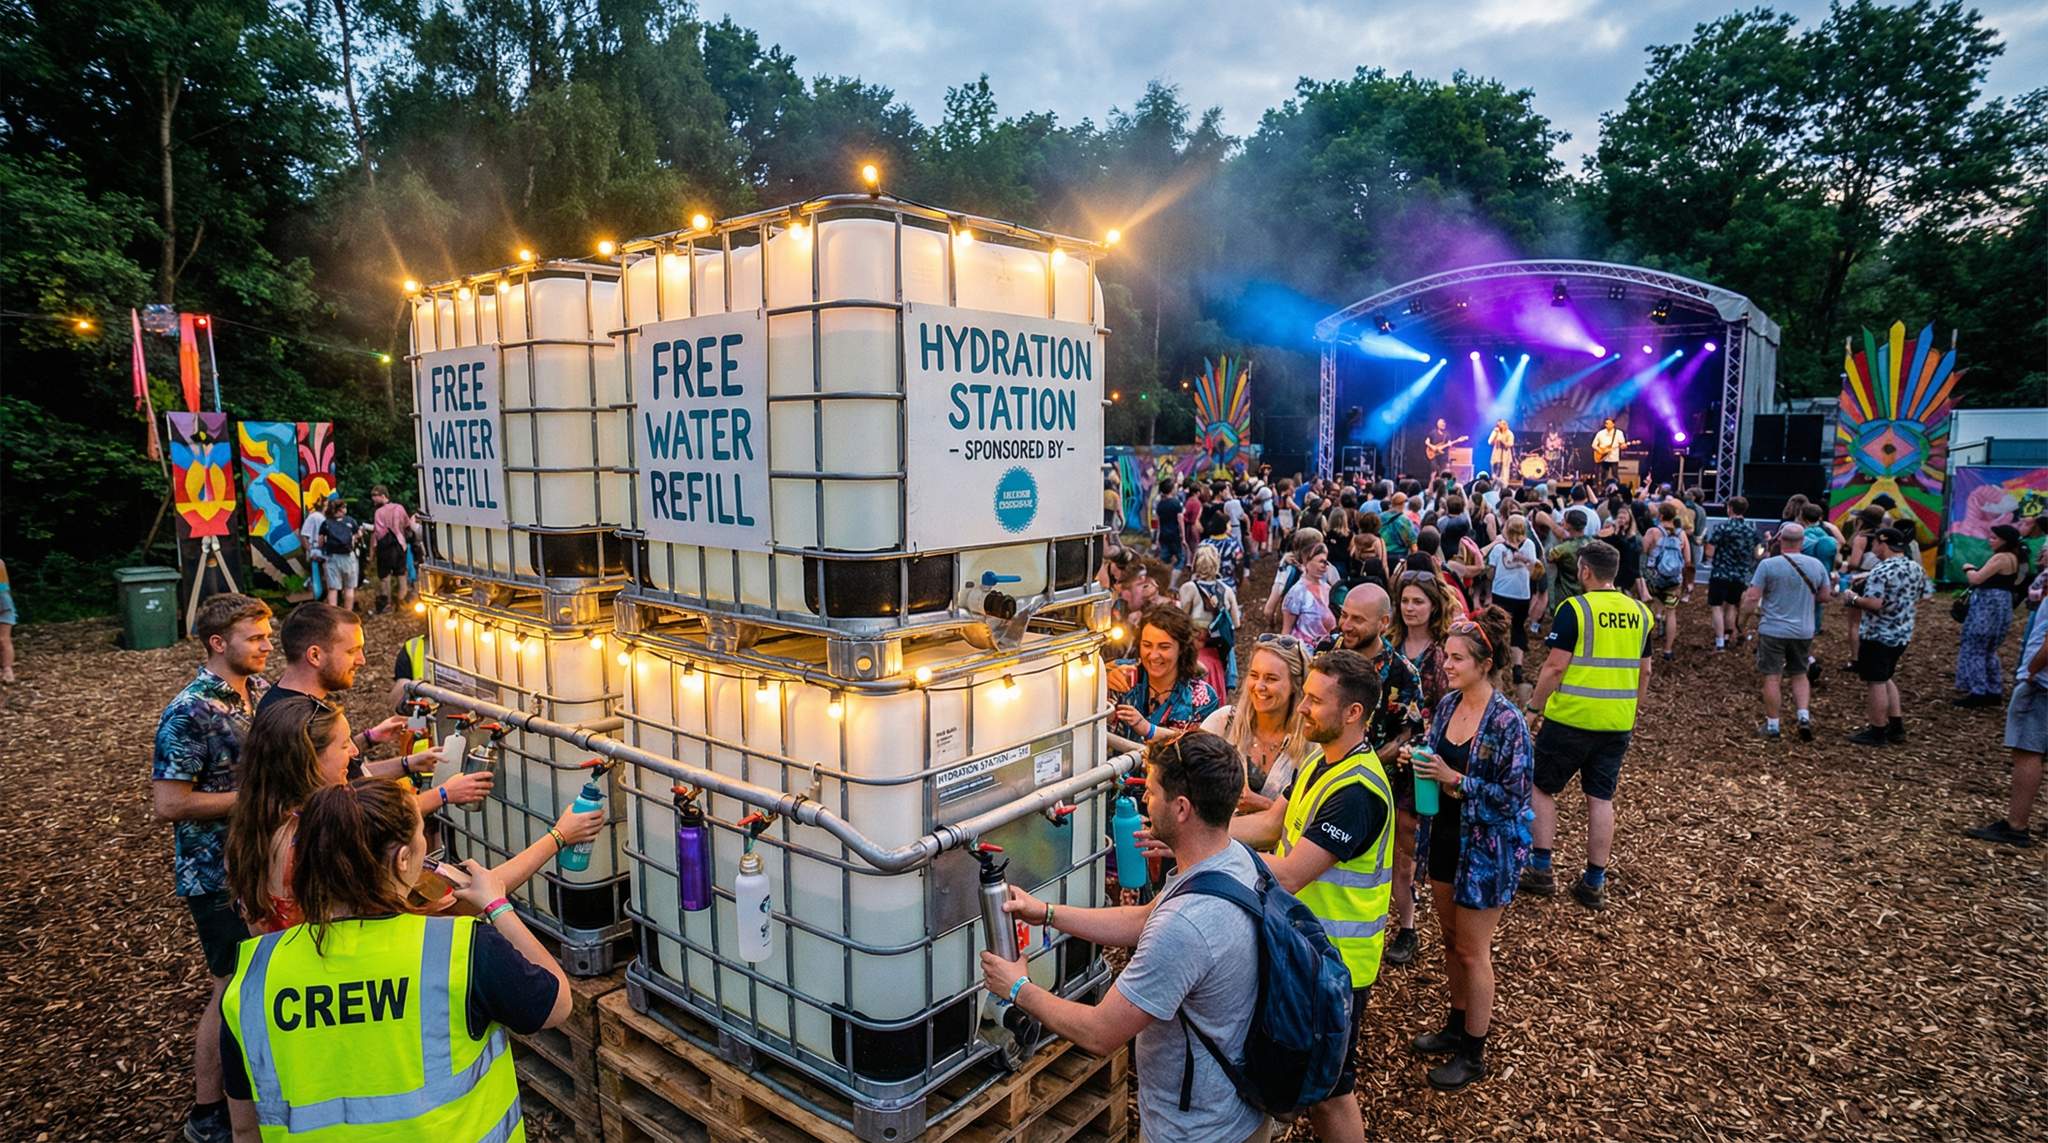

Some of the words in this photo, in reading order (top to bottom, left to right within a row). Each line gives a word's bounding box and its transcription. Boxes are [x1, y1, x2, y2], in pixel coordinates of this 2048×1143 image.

[652, 334, 745, 401] FREE
[919, 322, 1092, 382] HYDRATION
[431, 362, 487, 412] FREE
[948, 382, 1076, 431] STATION
[427, 418, 495, 461] WATER
[644, 407, 754, 462] WATER
[964, 439, 1044, 461] SPONSORED
[1048, 440, 1064, 459] BY
[432, 466, 498, 510] REFILL
[649, 469, 756, 527] REFILL
[1598, 612, 1640, 629] CREW
[1321, 822, 1353, 844] CREW
[273, 976, 410, 1032] CREW
